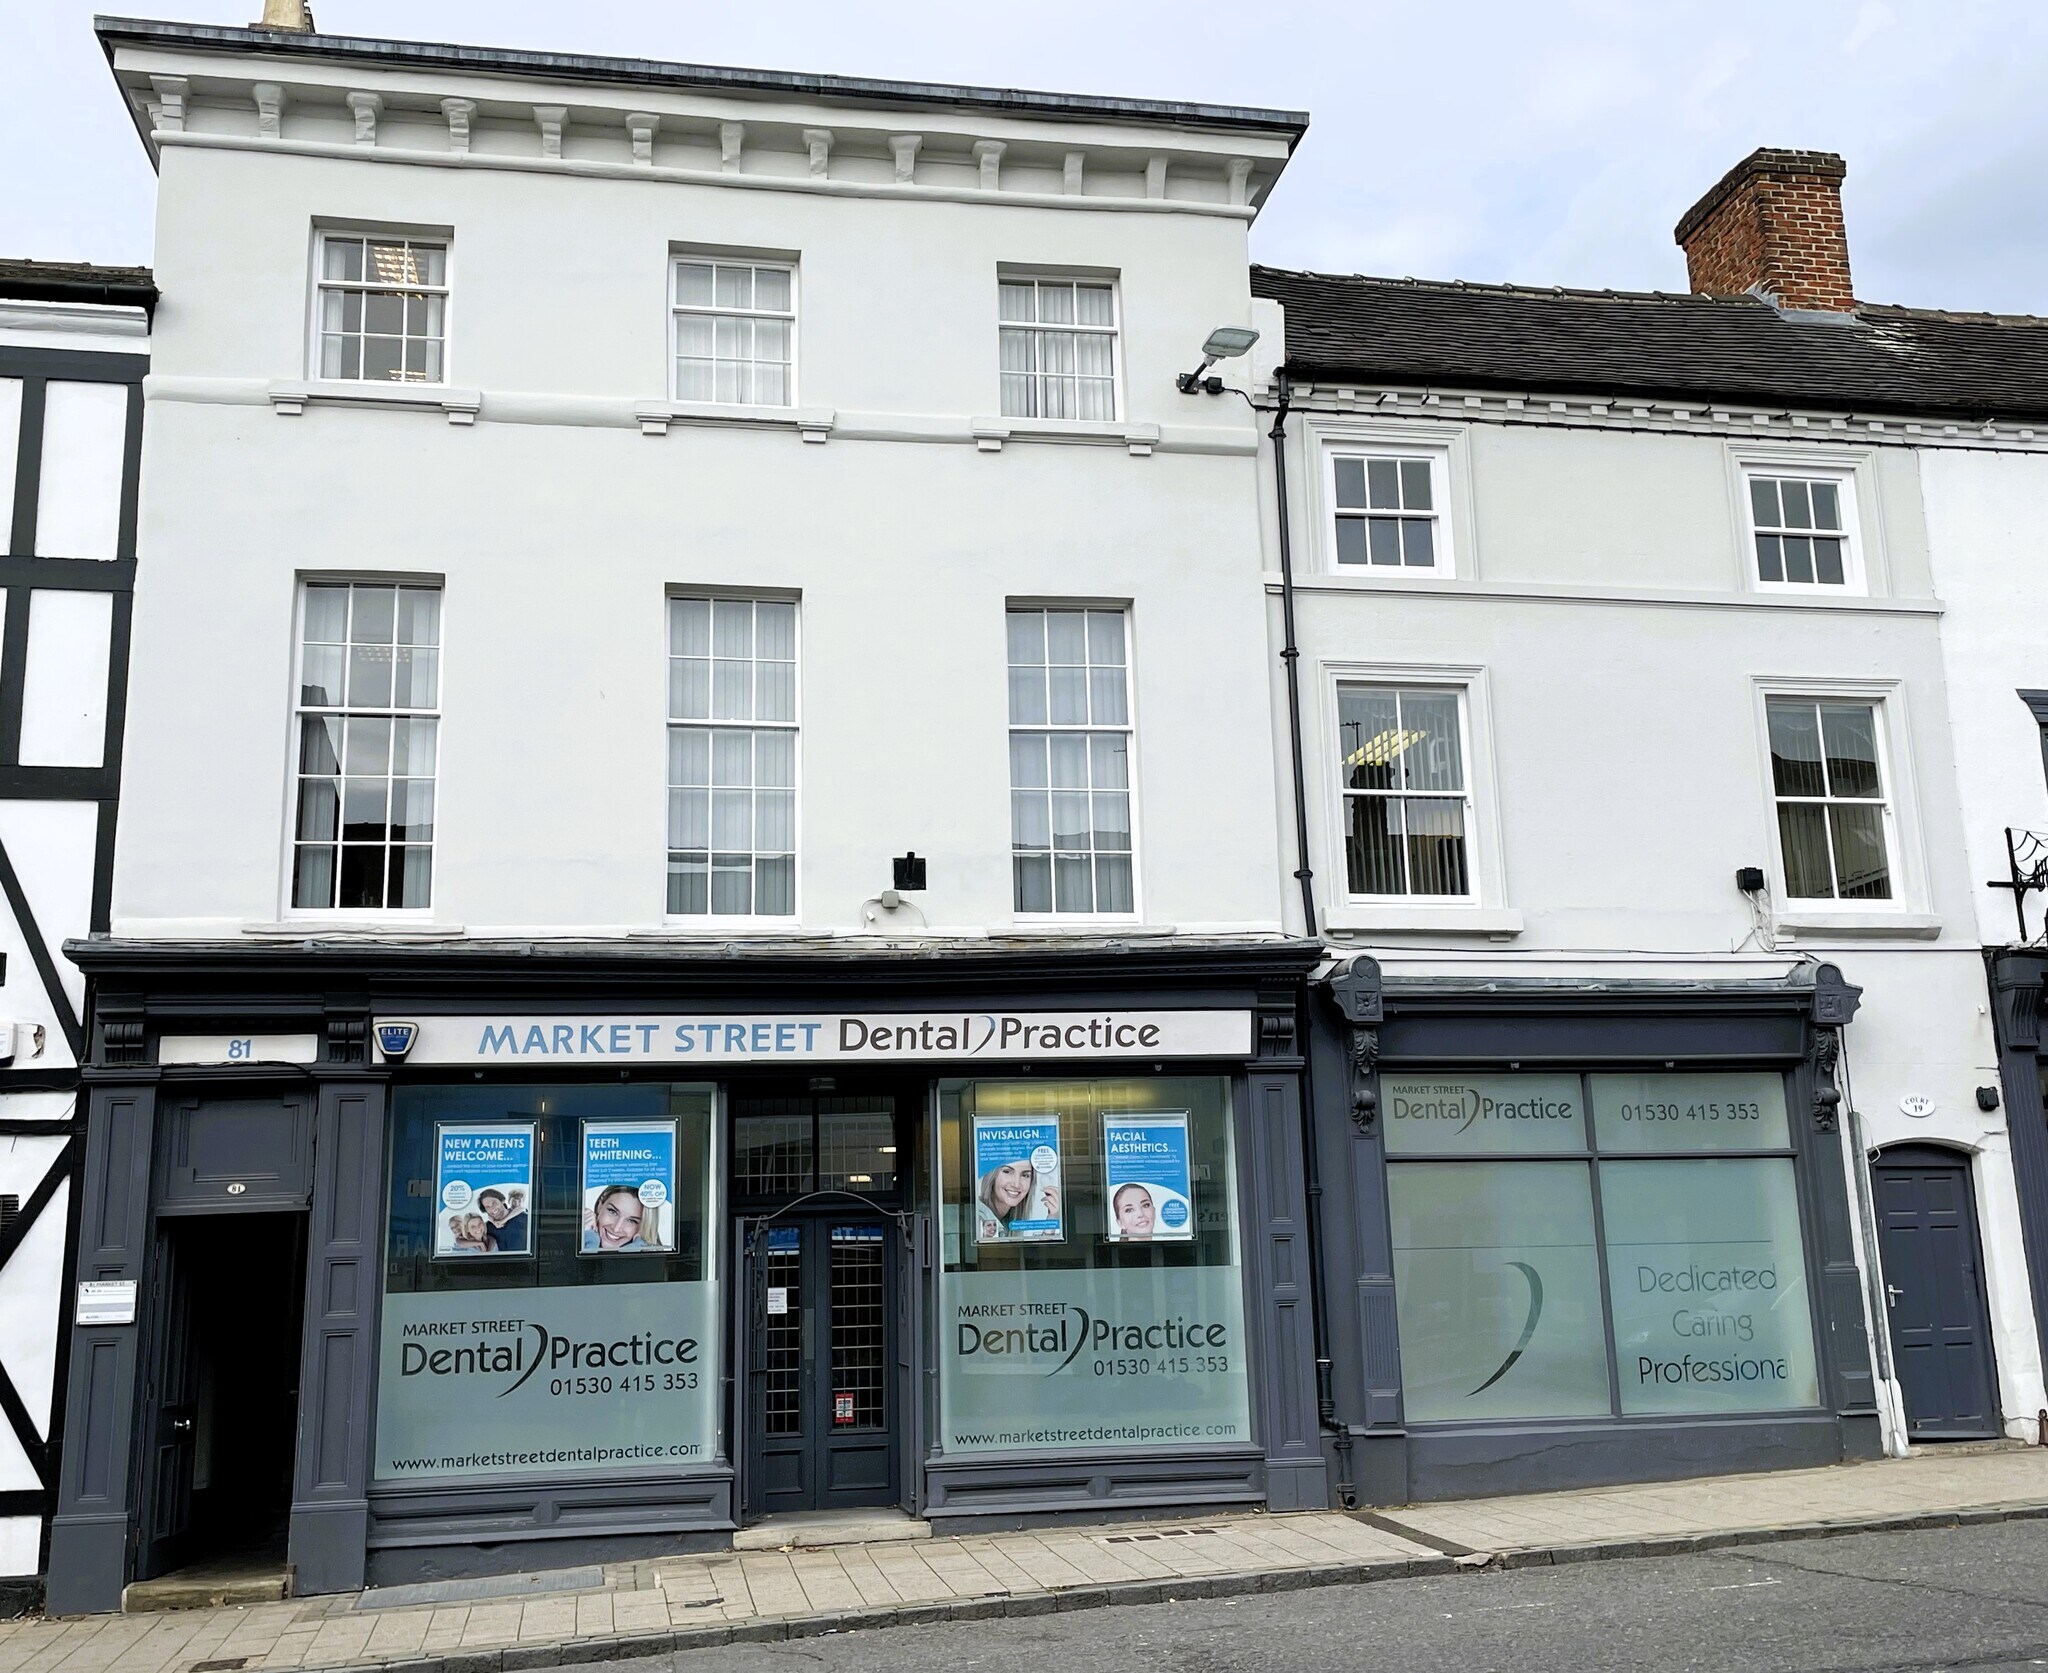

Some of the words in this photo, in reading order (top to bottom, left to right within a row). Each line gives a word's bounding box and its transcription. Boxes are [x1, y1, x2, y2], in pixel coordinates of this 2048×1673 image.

[381, 1028, 409, 1036] ELITE
[478, 1024, 660, 1056] MARKET
[674, 1023, 822, 1054] STREET
[838, 1017, 971, 1052] Dental
[999, 1016, 1161, 1050] Practice
[228, 1038, 252, 1059] 81
[1392, 1085, 1431, 1095] MARKET
[1433, 1085, 1465, 1095] STREET
[1393, 1097, 1467, 1120] Dental
[1482, 1096, 1573, 1120] Practice
[1621, 1104, 1680, 1121] 01530
[1686, 1103, 1720, 1121] 415
[1726, 1103, 1760, 1121] 353
[1913, 1104, 1923, 1113] 19
[445, 1138, 471, 1149] NEW
[474, 1138, 525, 1149] PATIENTS
[589, 1138, 620, 1149] TEETH
[1110, 1132, 1147, 1142] FACIAL
[231, 1185, 241, 1193] 81
[644, 1183, 662, 1191] NOW
[1637, 1262, 1778, 1293] Dedicated
[957, 1303, 1016, 1318] MARKET
[1019, 1302, 1068, 1316] STREET
[402, 1321, 467, 1337] MARKET
[471, 1319, 526, 1334] STREET
[1672, 1308, 1755, 1342] Caring
[958, 1318, 1068, 1356] Dental
[1092, 1316, 1227, 1352] Practice
[401, 1337, 523, 1377] Dental
[550, 1331, 699, 1370] Practice
[1094, 1358, 1150, 1377] 01530
[1156, 1357, 1189, 1375] 415
[1195, 1355, 1229, 1374] 353
[550, 1375, 613, 1396] 01530
[619, 1373, 655, 1393] 415
[663, 1371, 699, 1391] 353
[955, 1423, 1237, 1446] www.marketstreetdentalpractice.com
[392, 1442, 702, 1472] www.marketstreetdentalpractice.com
